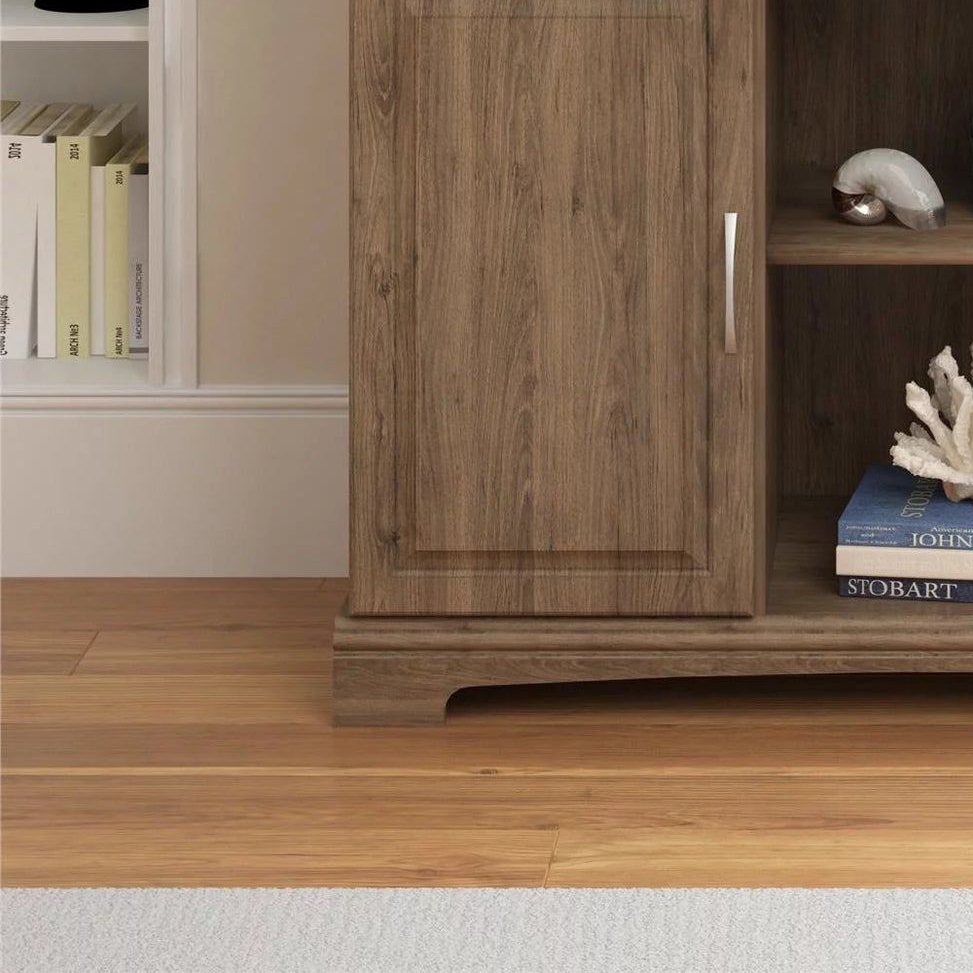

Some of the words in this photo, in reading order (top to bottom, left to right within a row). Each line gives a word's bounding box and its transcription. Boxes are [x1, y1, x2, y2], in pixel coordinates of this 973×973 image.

[69, 143, 79, 159] 2014
[115, 170, 123, 184] 2014
[135, 263, 143, 305] ARCHITECTURE
[69, 338, 79, 356] ARCH
[115, 339, 123, 355] ARCH
[930, 526, 973, 534] American
[911, 532, 973, 548] JOHN
[848, 578, 958, 599] STOBART
